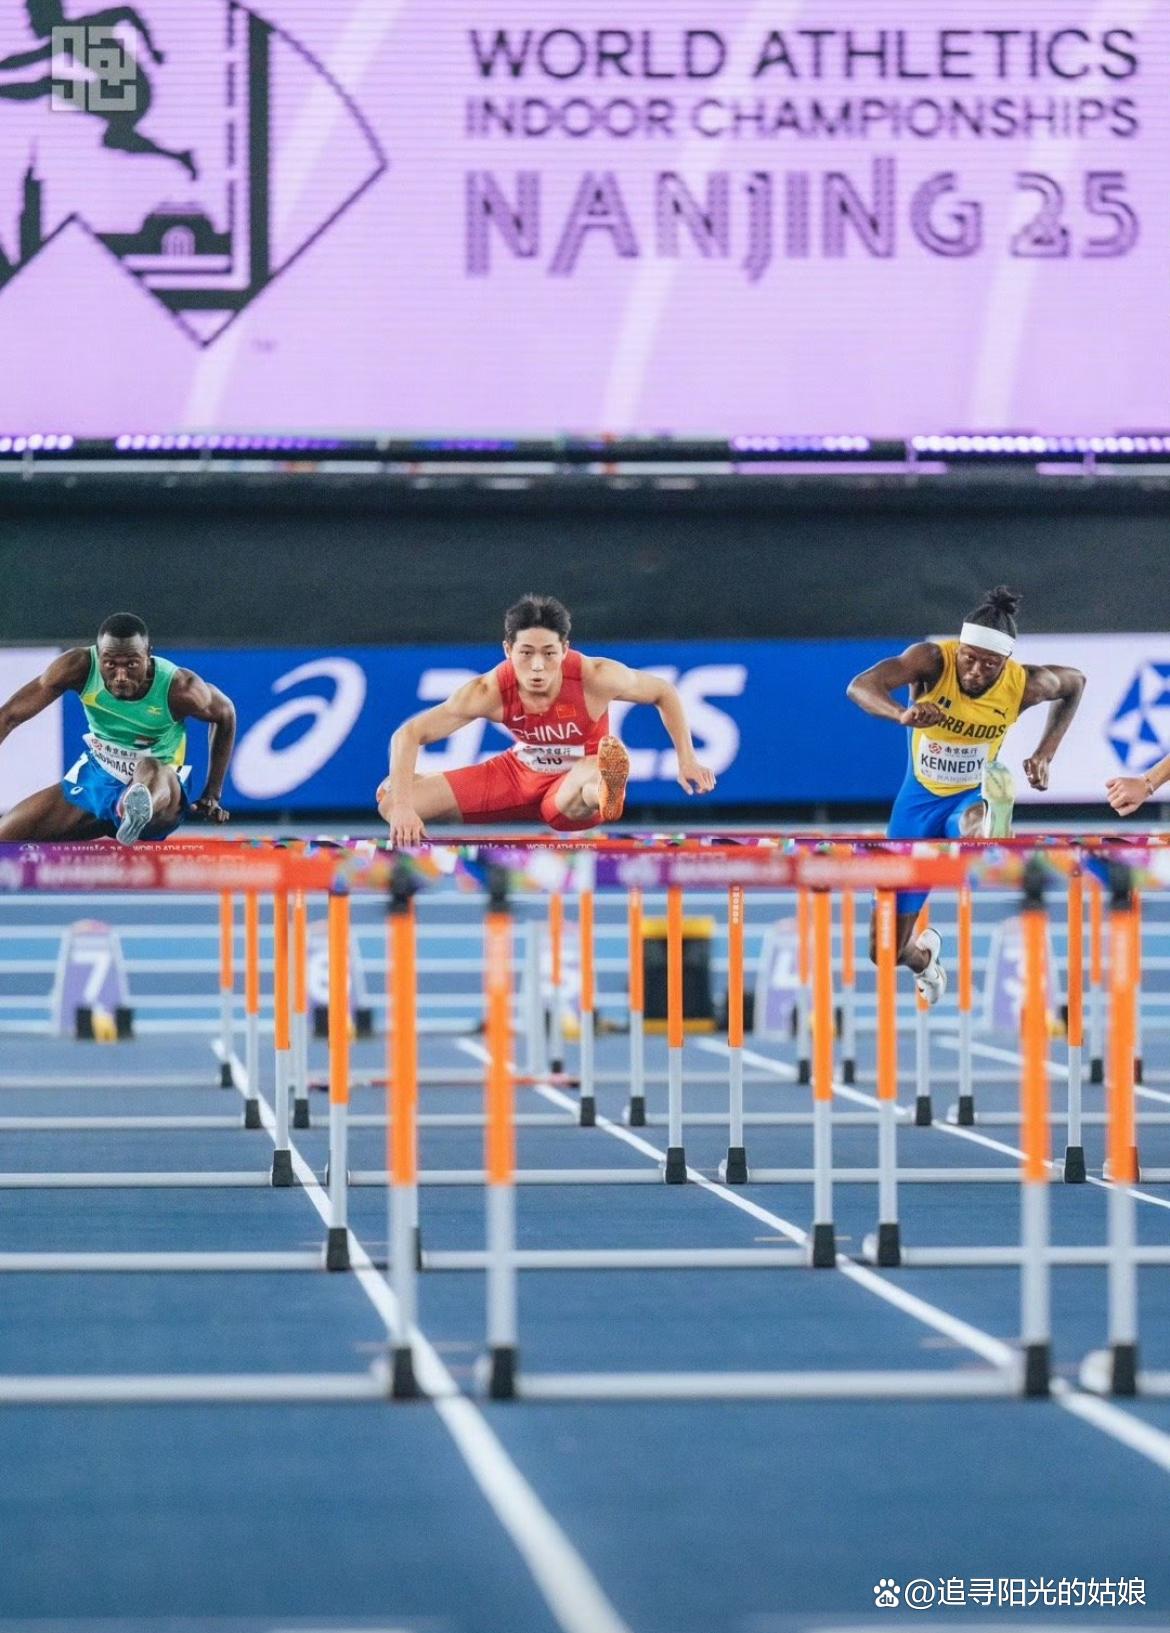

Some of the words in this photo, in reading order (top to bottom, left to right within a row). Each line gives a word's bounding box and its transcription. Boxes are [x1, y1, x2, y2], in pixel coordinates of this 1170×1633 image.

[469, 27, 727, 79] WORLD
[750, 28, 1139, 79] ATHLETICS
[465, 97, 676, 137] INDOOR
[691, 97, 1140, 138] CHAMPIONSHIPS
[1010, 170, 1142, 259] 25
[921, 753, 985, 774] KENNEDY
[70, 951, 112, 1004] 7
